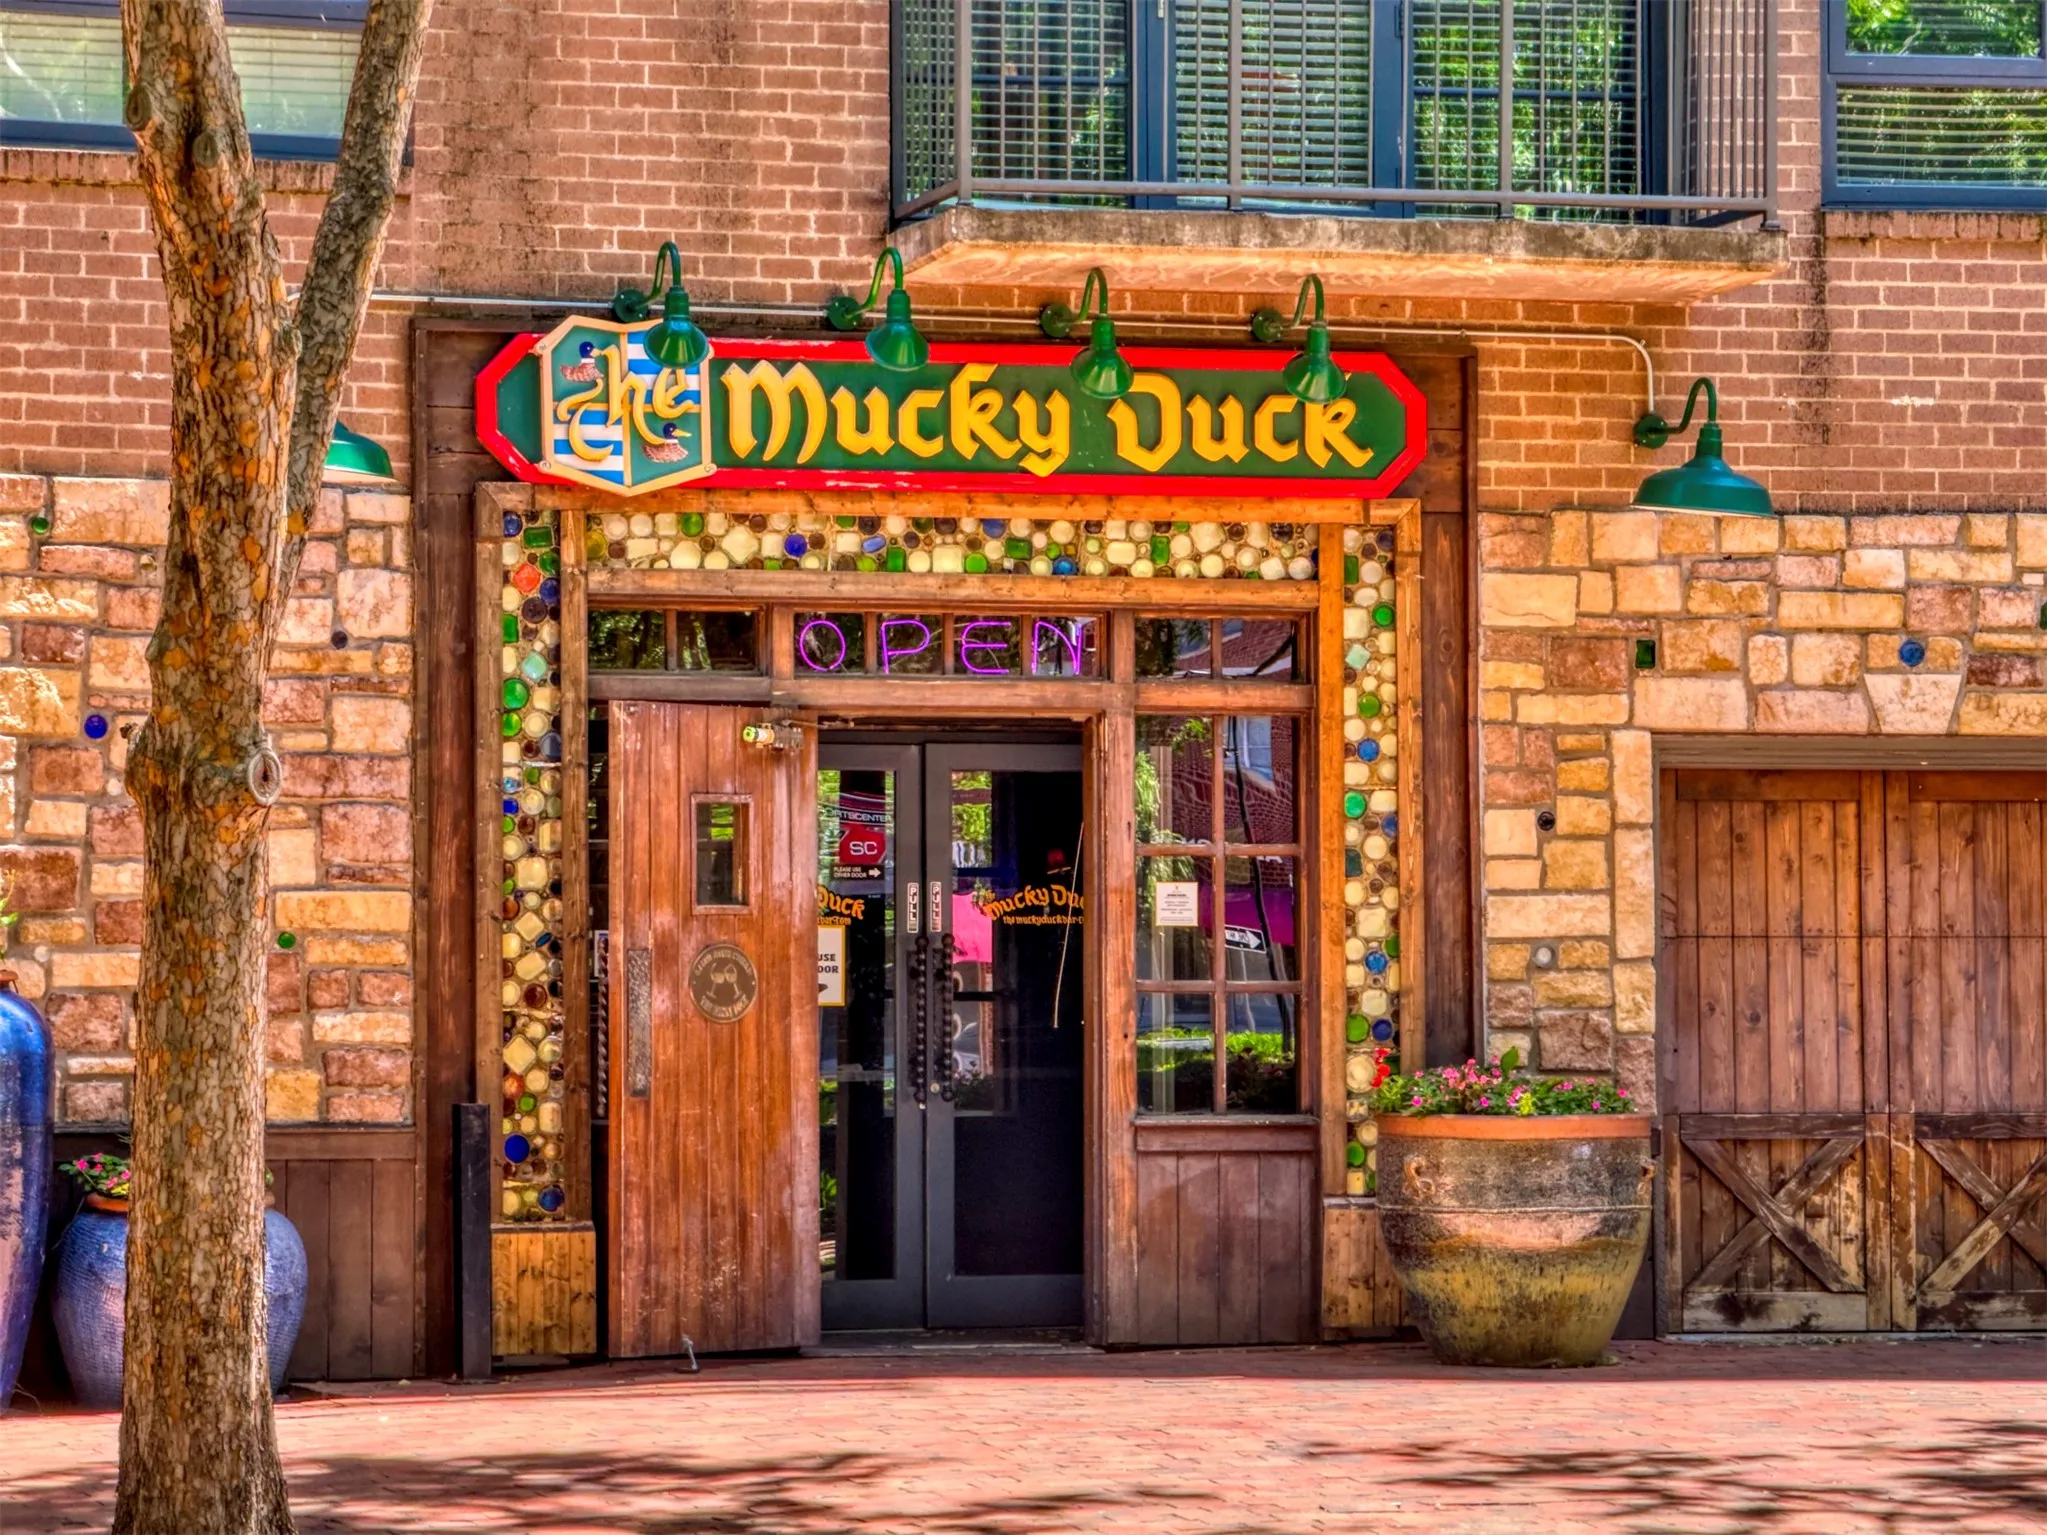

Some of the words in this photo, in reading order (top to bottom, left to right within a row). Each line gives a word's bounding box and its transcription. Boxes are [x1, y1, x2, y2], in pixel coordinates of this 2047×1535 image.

[721, 363, 1071, 477] Mucky
[1107, 372, 1375, 473] Duck
[798, 618, 1084, 675] OPEN
[822, 807, 892, 822] ORTSCENTER
[849, 841, 878, 856] SC
[909, 886, 918, 921] PULL
[932, 886, 941, 920] PULL
[817, 965, 839, 974] OOR
